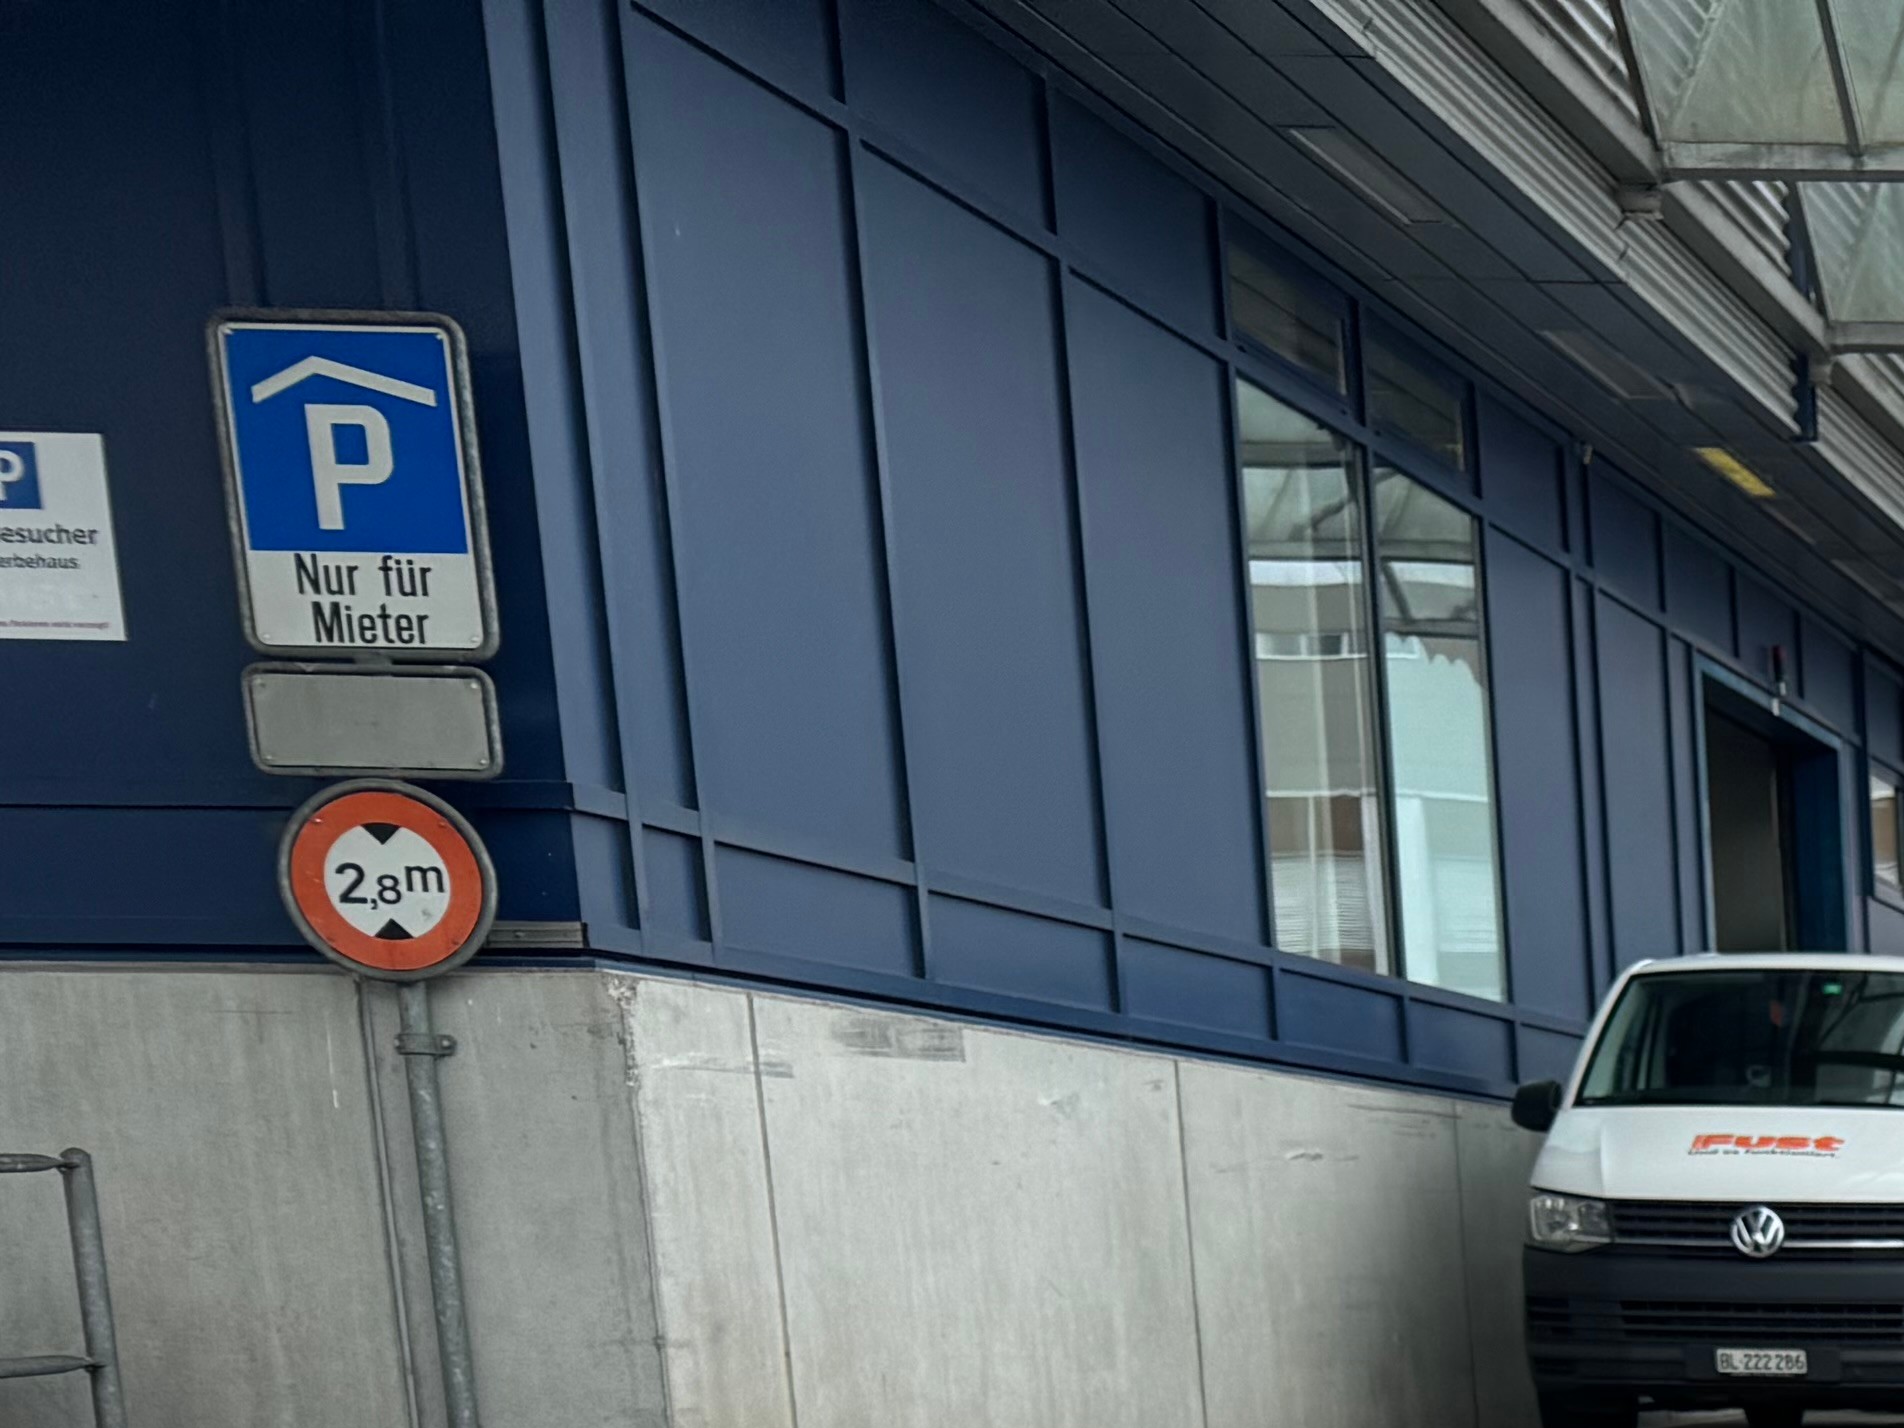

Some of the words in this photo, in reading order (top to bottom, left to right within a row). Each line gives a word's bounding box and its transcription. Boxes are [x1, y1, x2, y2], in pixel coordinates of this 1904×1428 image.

[304, 403, 395, 531] P
[0, 523, 101, 546] esucher
[0, 554, 81, 570] erbehaus
[294, 552, 359, 599] Nur
[378, 553, 432, 600] für
[312, 602, 430, 646] Mieter
[1690, 1133, 1845, 1152] Fust
